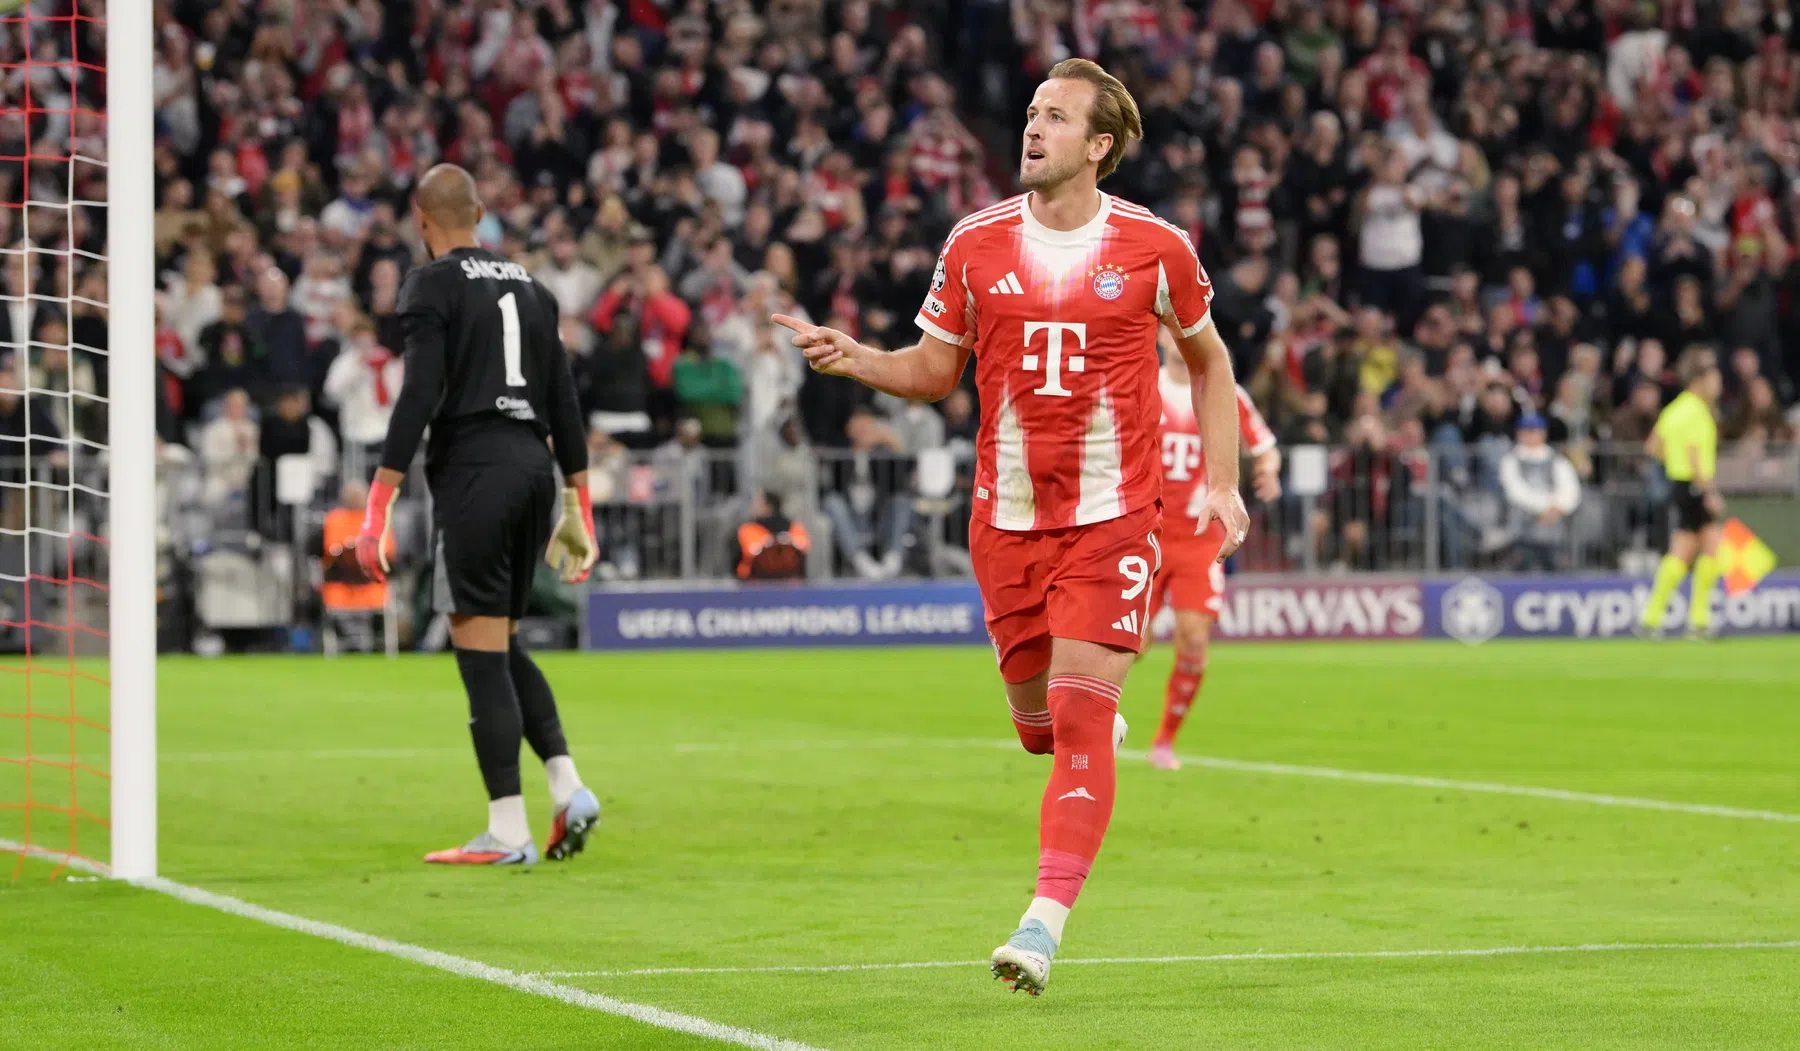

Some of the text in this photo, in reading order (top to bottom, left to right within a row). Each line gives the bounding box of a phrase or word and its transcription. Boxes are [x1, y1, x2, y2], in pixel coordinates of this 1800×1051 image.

[498, 292, 527, 387] 1
[1022, 321, 1087, 397] T
[1161, 432, 1201, 482] T
[1118, 555, 1149, 600] 9
[617, 603, 973, 639] UEFA CHAMPIONS LEAGUE
